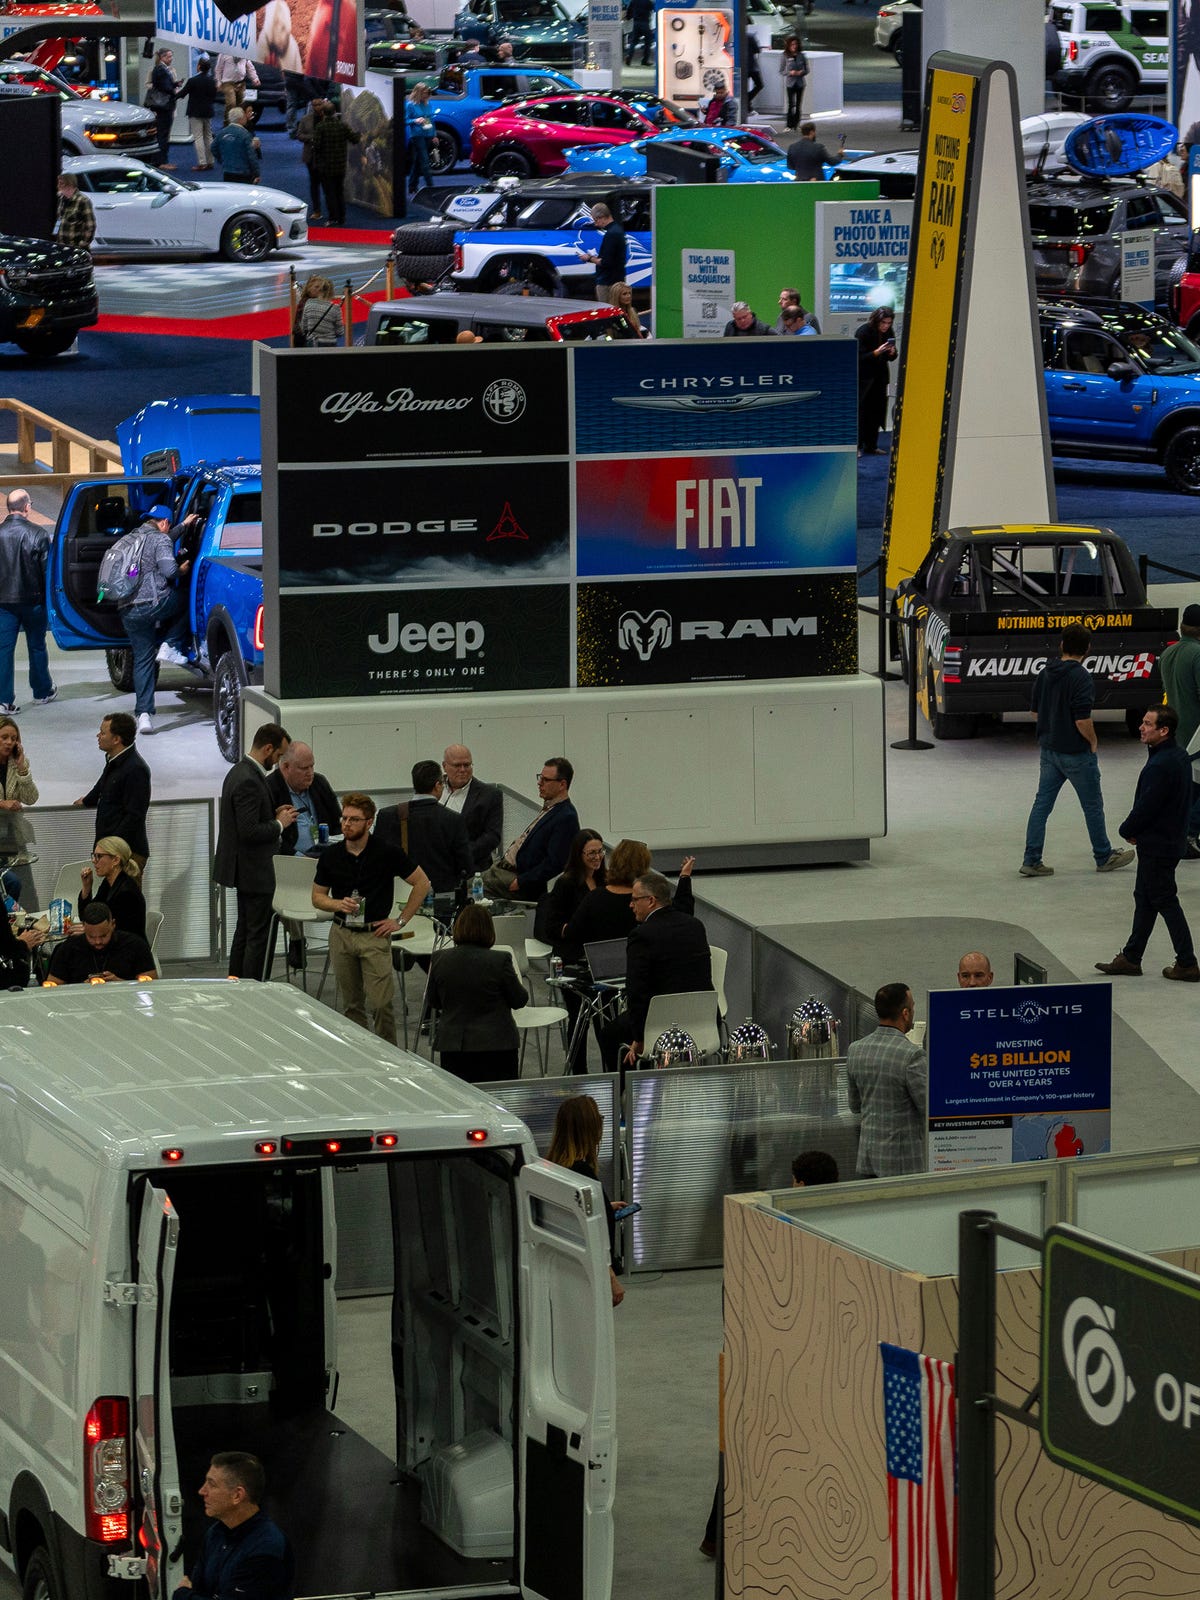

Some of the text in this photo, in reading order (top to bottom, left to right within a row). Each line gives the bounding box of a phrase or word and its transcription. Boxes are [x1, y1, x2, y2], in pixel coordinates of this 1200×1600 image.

[934, 133, 960, 160] NOTHING
[936, 158, 955, 182] STOPS
[928, 181, 956, 227] RAM
[850, 209, 892, 224] TAKE A
[834, 225, 910, 241] PHOTO WITH
[835, 241, 908, 259] SASQUATCH
[688, 255, 730, 265] TUG-O-WAR
[699, 265, 718, 274] WITH
[688, 274, 731, 285] SASQUATCH
[639, 374, 794, 389] CHRYSLER
[500, 381, 525, 402] ROMEO
[319, 387, 474, 424] Alfa Romeo
[676, 477, 763, 550] FIAT
[313, 519, 478, 537] DODGE
[680, 616, 818, 641] RAM
[998, 613, 1133, 630] NOTHING STOPS RAM
[368, 612, 485, 659] Jeep
[368, 666, 485, 680] THERE'S ONLY ONE
[966, 655, 1134, 677] KAULIG CING
[960, 1003, 1083, 1020] STELLANTIS
[996, 1039, 1043, 1049] INVESTING
[969, 1050, 1071, 1069] $13 BILLION
[970, 1067, 1071, 1079] IN THE UNITED STATES
[989, 1077, 1053, 1089] OVER 4 YEARS
[945, 1097, 969, 1105] Largest
[1011, 1094, 1044, 1103] Company's
[1045, 1092, 1072, 1100] 100-year
[1073, 1091, 1095, 1100] history
[946, 1120, 980, 1128] INVESTMENT
